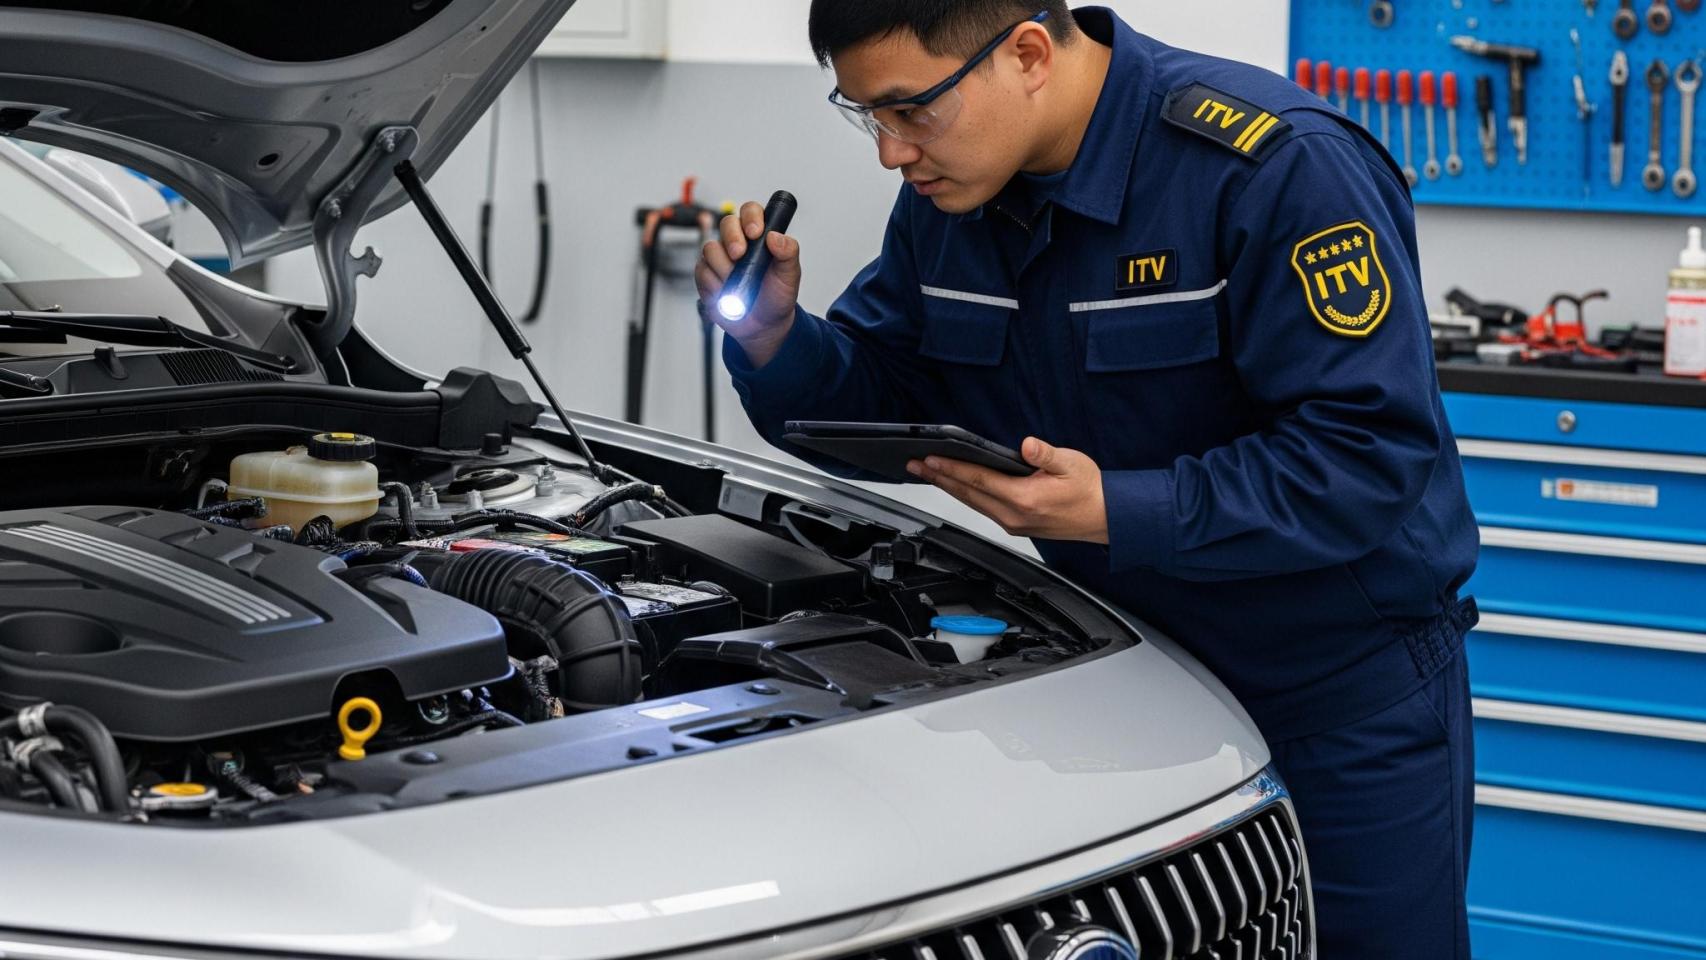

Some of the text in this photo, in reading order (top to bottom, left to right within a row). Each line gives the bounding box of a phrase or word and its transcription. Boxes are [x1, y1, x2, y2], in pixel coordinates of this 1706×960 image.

[1193, 99, 1245, 129] ITV
[1128, 256, 1166, 283] ITV
[1314, 256, 1370, 300] ITV
